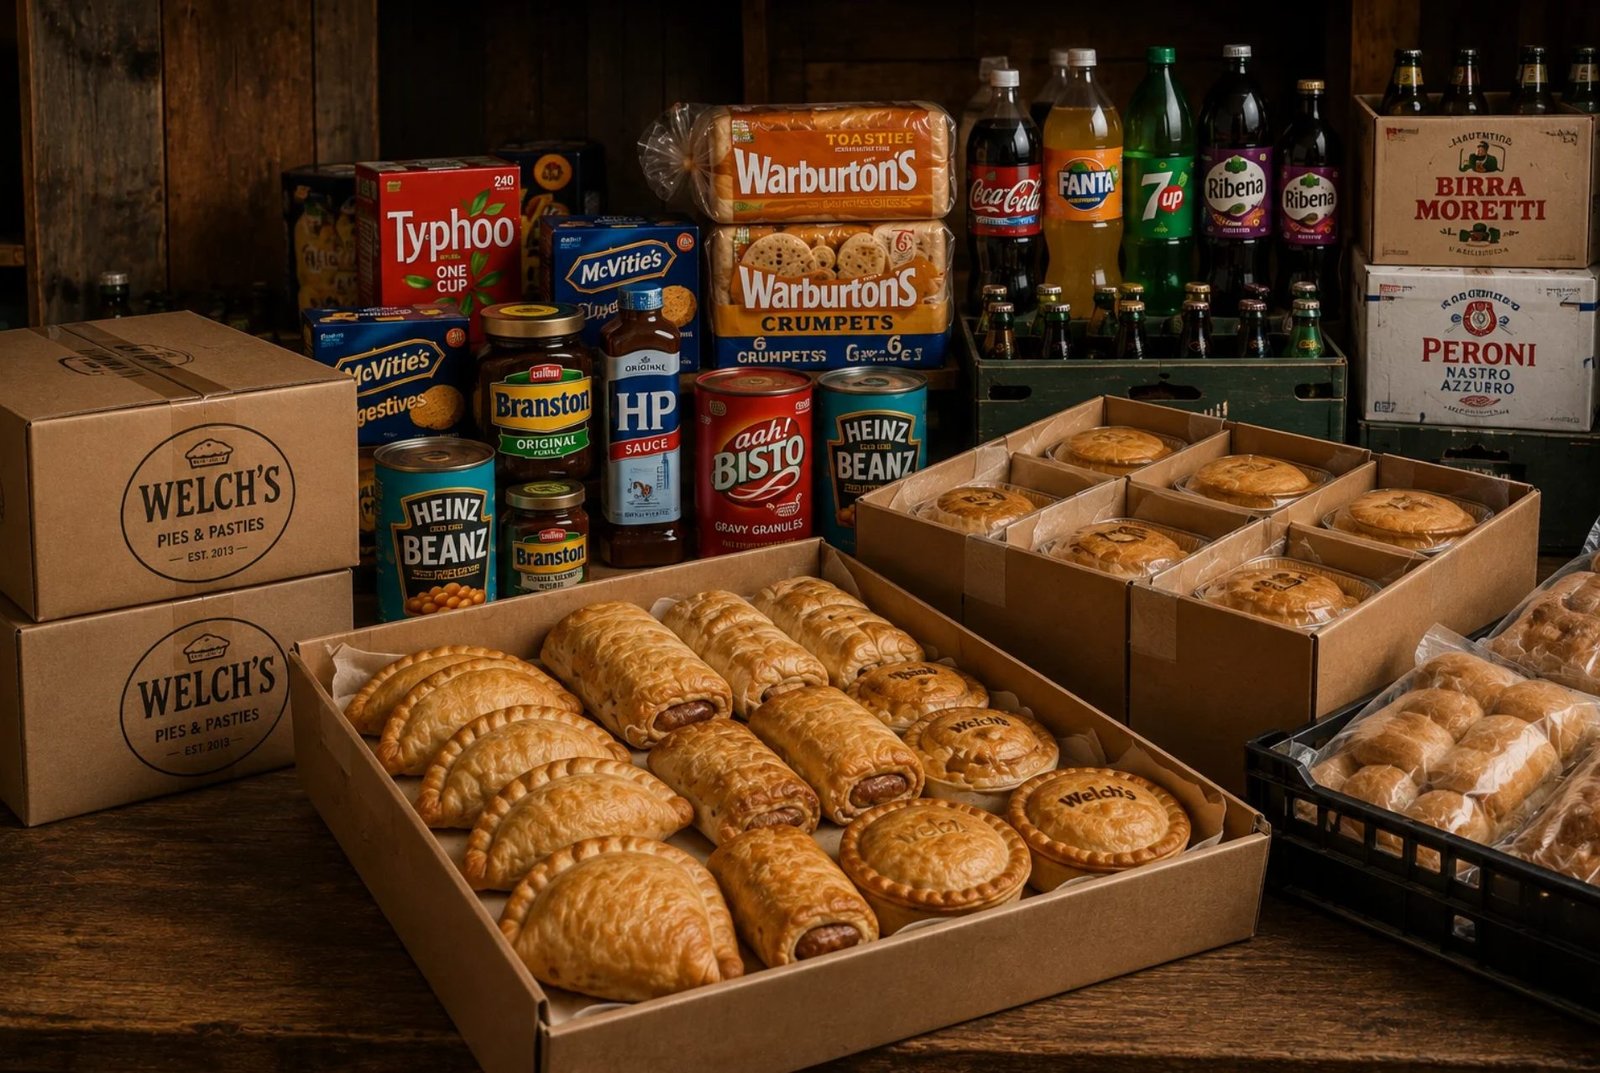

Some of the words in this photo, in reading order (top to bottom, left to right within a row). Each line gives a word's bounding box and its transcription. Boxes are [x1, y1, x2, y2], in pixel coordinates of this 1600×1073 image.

[494, 175, 514, 188] 240
[1058, 170, 1115, 196] FANTA
[1208, 177, 1264, 200] Ribena
[1435, 176, 1526, 197] BIRRA
[1285, 190, 1335, 209] Ribena
[1414, 200, 1546, 221] MORETTI
[387, 207, 515, 264] Typhoo
[436, 264, 468, 279] ONE
[580, 249, 663, 285] McVitie's
[437, 279, 468, 293] CUP
[761, 315, 894, 332] CRUMPETS
[753, 337, 767, 350] 6
[1421, 337, 1537, 367] PERONI
[344, 348, 430, 386] McVitie's
[1446, 367, 1511, 381] NASTRO
[357, 394, 428, 428] gestives
[495, 390, 590, 418] Branston
[616, 390, 677, 431] HP
[516, 435, 577, 450] ORIGINAL
[735, 417, 792, 449] aah!
[845, 419, 909, 443] HEINZ
[625, 438, 668, 455] SAUCE
[713, 435, 804, 491] BISTO
[837, 450, 916, 481] BEANZ
[138, 464, 281, 523] WELCH'S
[411, 498, 481, 526] HEINZ
[157, 530, 189, 548] PIES
[194, 528, 204, 542] &
[209, 517, 265, 539] PASTIES
[715, 521, 749, 535] GRAVY
[752, 518, 804, 535] GRANULES
[188, 551, 208, 563] EST.
[211, 545, 234, 558] 2013
[403, 527, 488, 566] BEANZ
[516, 544, 584, 566] Branston
[137, 655, 276, 719] WELCH'S
[155, 724, 186, 743] PIES
[191, 721, 201, 735] &
[206, 708, 260, 732] PASTIES
[207, 737, 230, 752] 2013
[1058, 785, 1137, 808] Welch's
